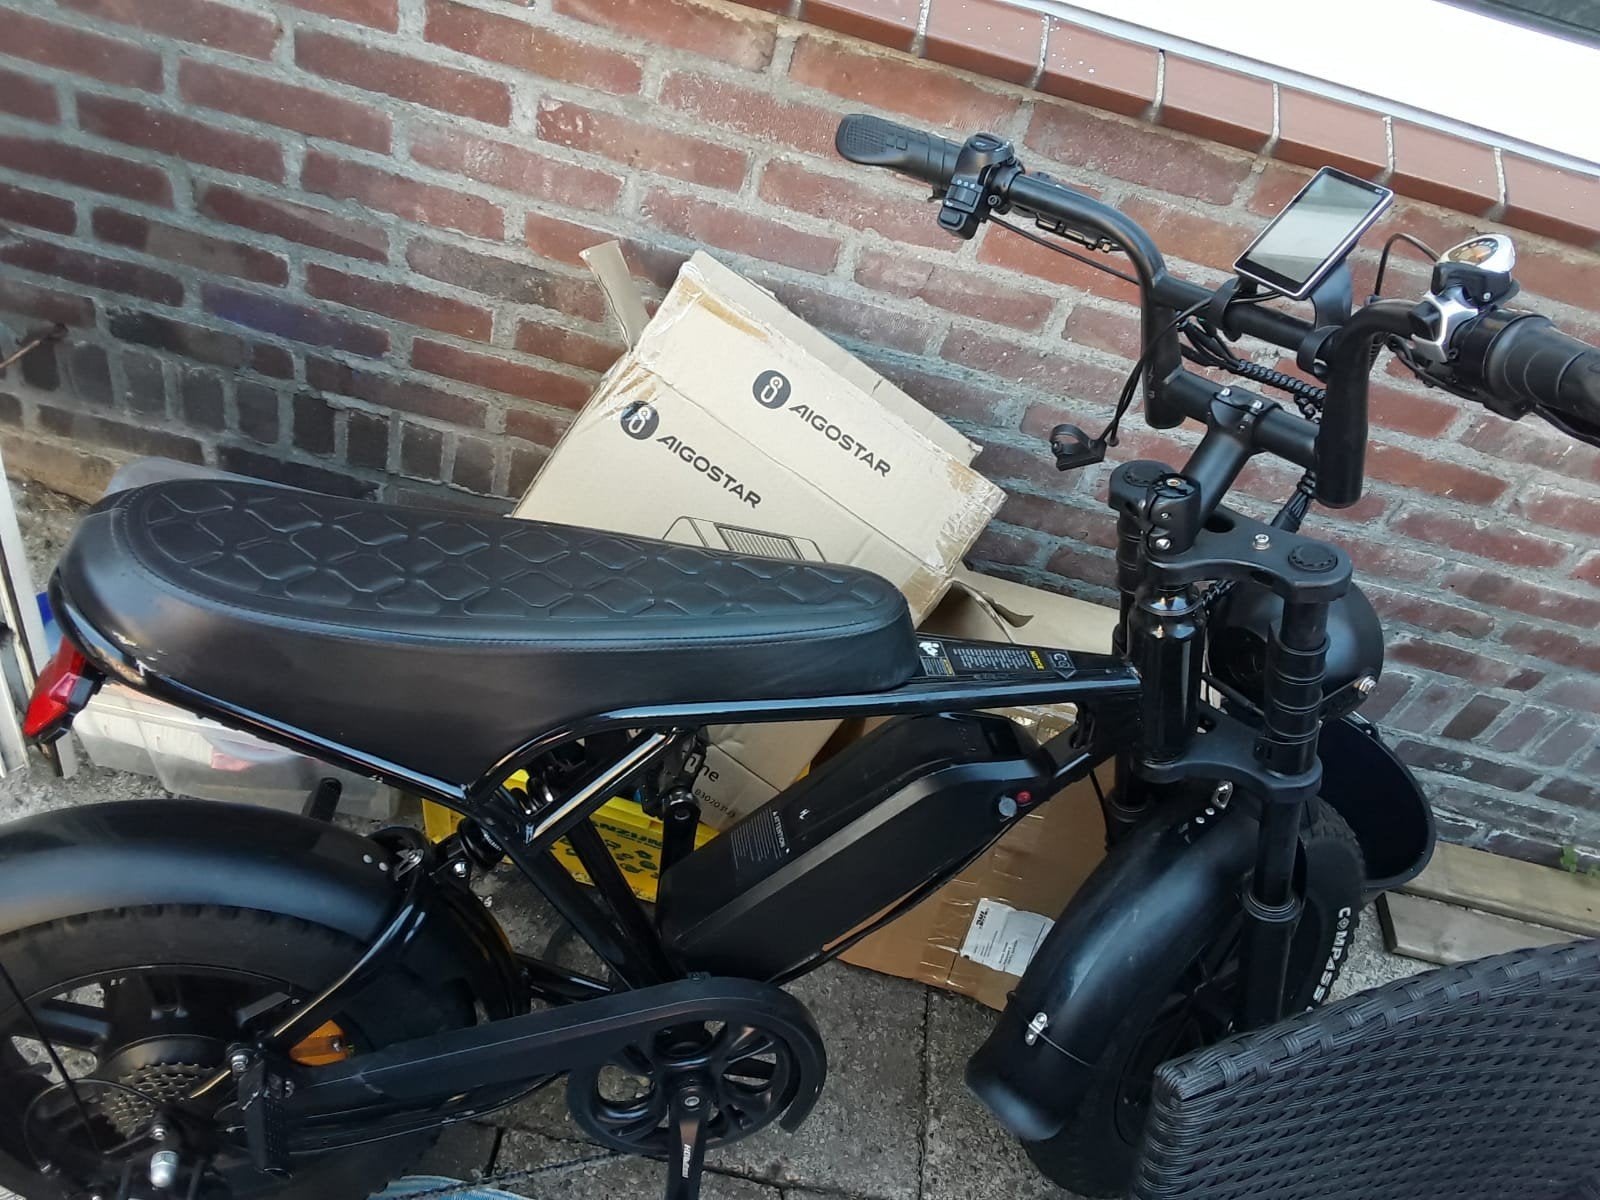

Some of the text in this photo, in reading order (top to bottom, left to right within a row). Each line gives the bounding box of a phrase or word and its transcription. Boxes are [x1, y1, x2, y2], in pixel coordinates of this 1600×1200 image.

[657, 435, 762, 508] AIGOSTAR
[789, 404, 891, 477] AIGOSTAR
[1030, 651, 1045, 670] NOTICE
[1312, 906, 1351, 1003] COMPASS
